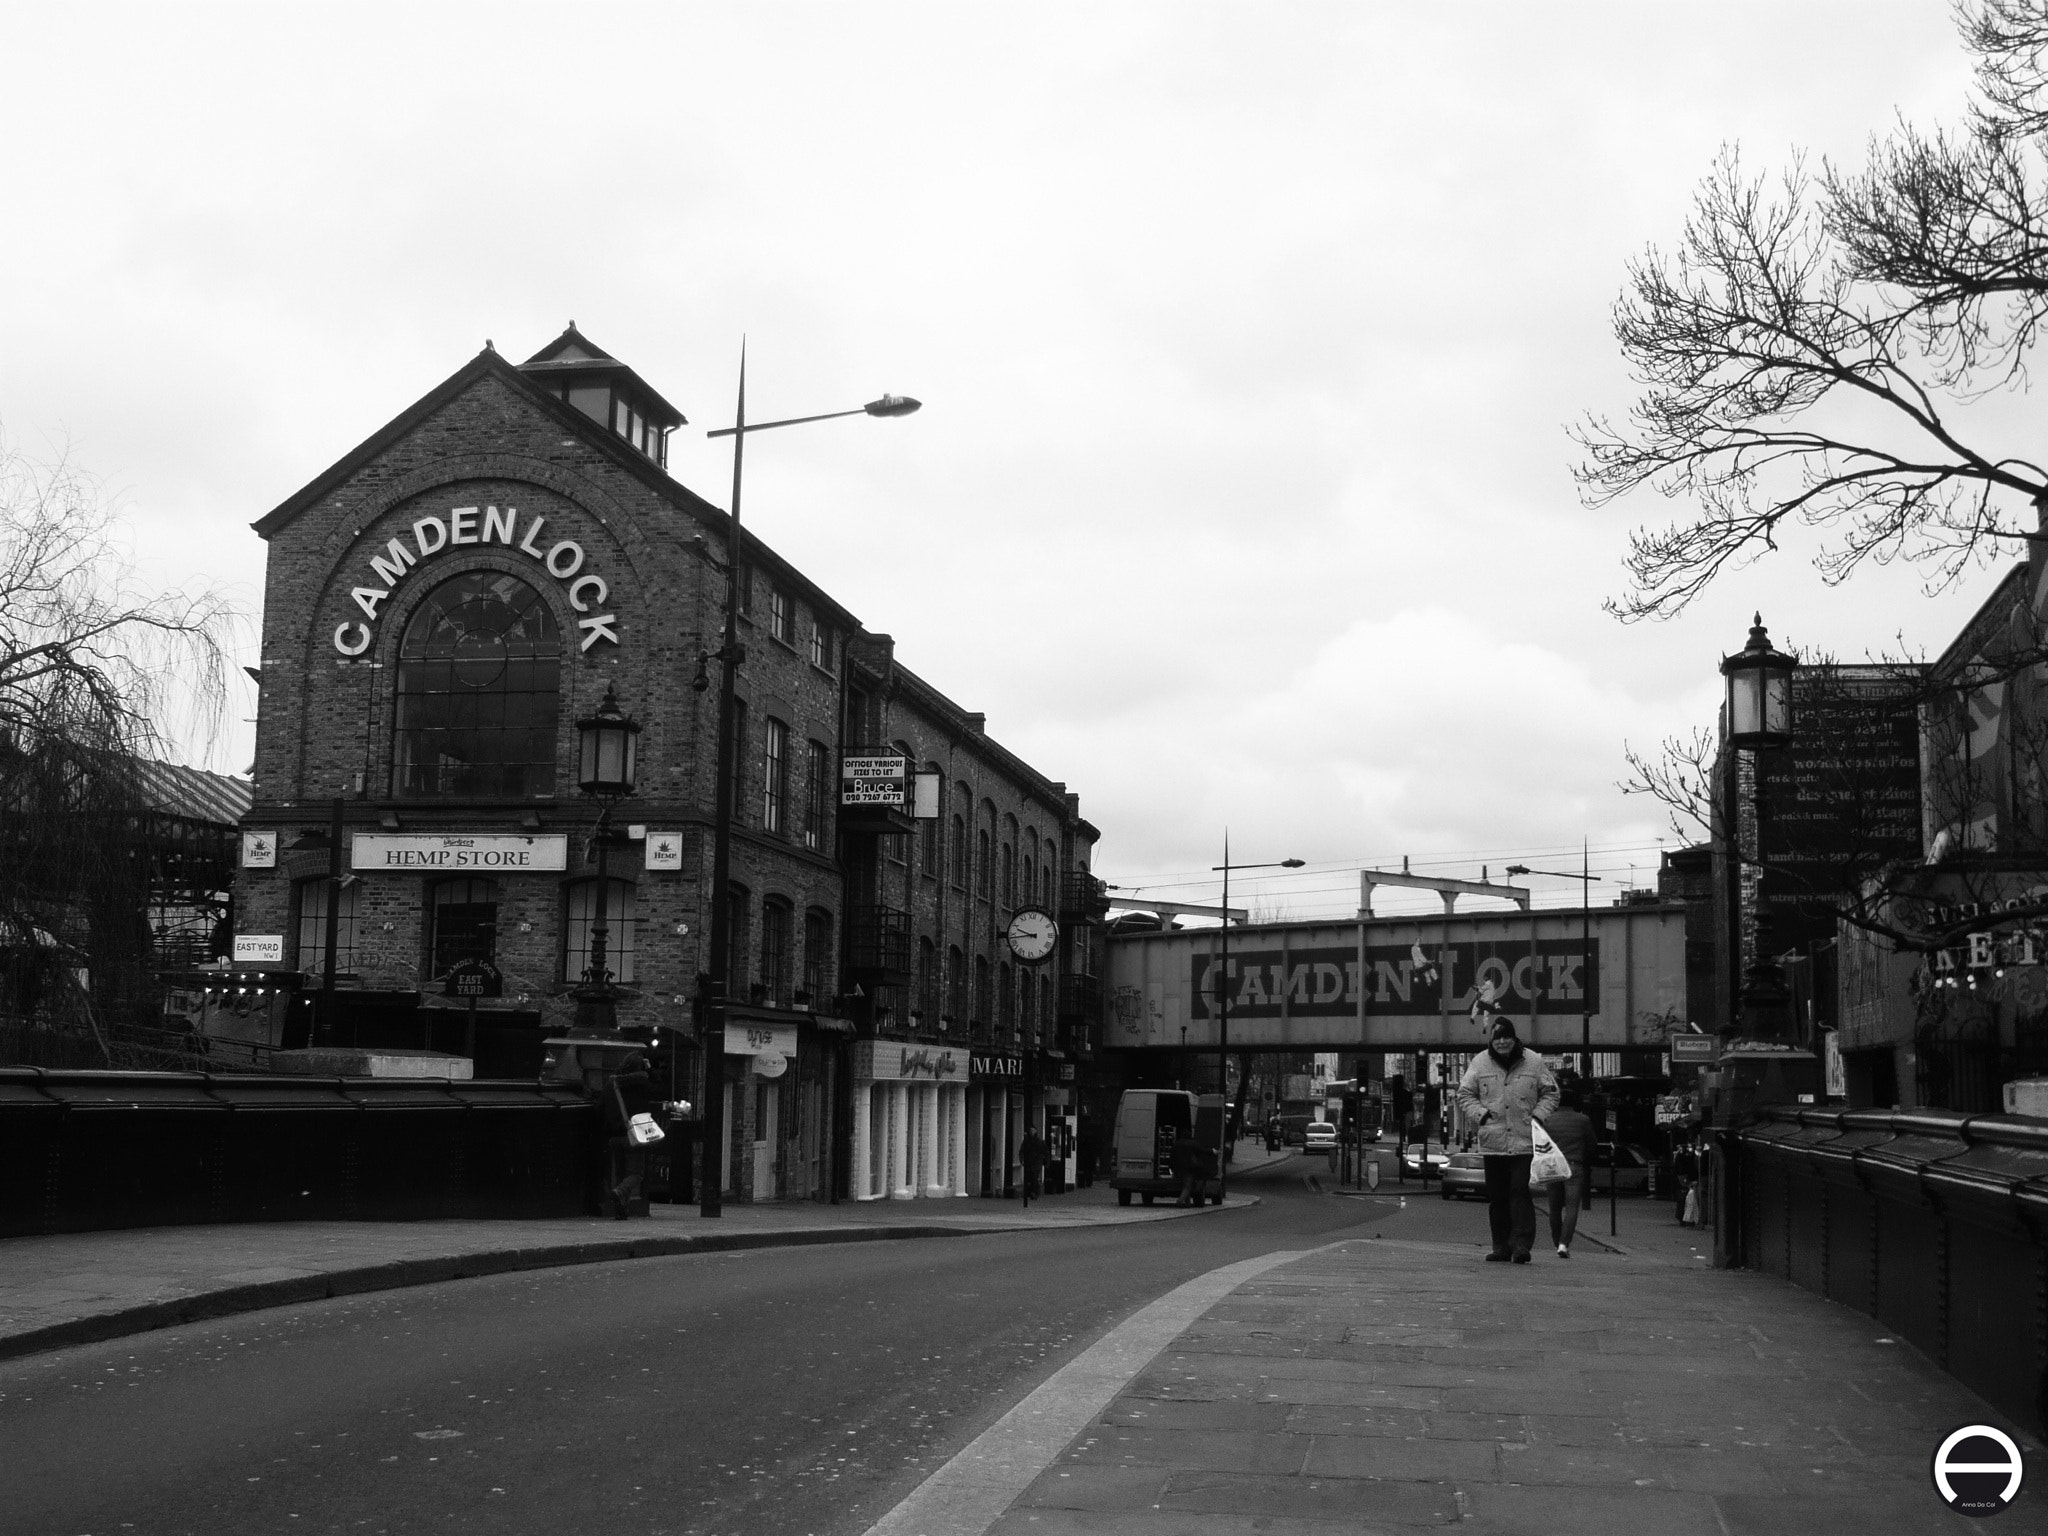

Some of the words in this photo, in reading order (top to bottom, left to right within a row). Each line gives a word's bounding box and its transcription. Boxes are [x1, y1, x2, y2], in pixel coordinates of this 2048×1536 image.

[334, 506, 517, 656] CAMDEN
[519, 515, 619, 653] LOCK
[845, 760, 872, 768] OFFICES
[874, 760, 903, 768] VARIOUS
[871, 768, 881, 776] TO
[883, 768, 894, 776] LET
[854, 779, 894, 793] Bruce
[386, 851, 450, 865] HEMP
[456, 851, 531, 866] STORE
[236, 942, 256, 951] EAST
[257, 942, 279, 951] YARD
[458, 974, 483, 985] EAST
[1201, 957, 1412, 1014] CAMDEN
[1438, 949, 1584, 1011] LOCK
[456, 985, 484, 995] YARD
